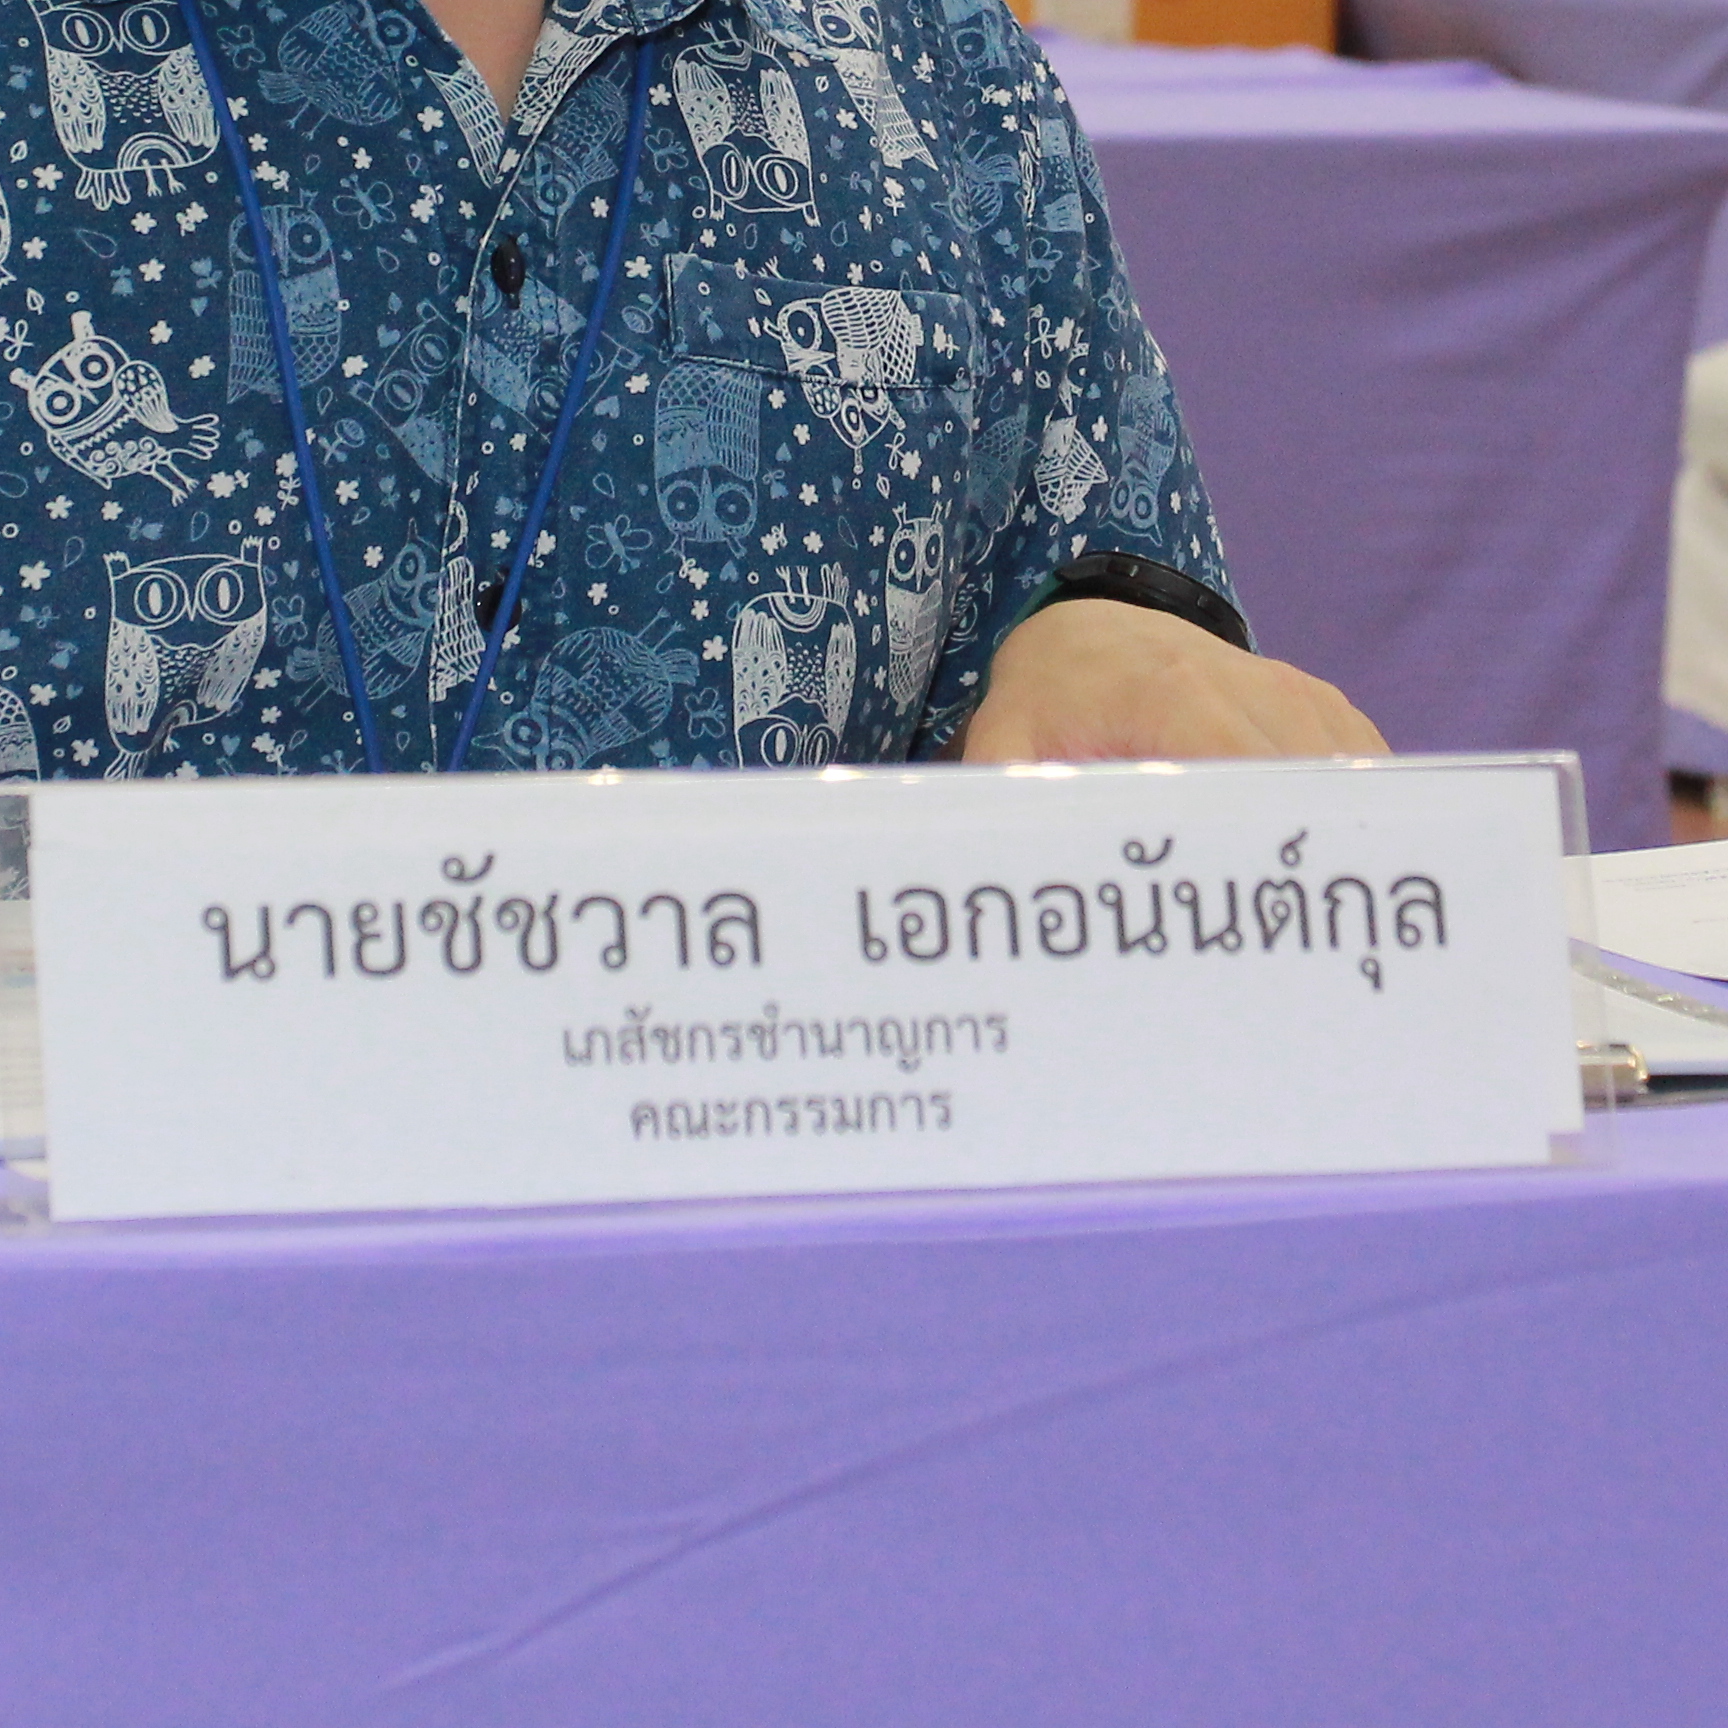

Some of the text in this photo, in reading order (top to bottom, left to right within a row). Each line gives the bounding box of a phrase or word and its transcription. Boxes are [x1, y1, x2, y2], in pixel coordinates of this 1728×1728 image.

[203, 830, 1448, 993] นายชัชวาล เอกอนันต์กุล
[562, 1002, 1009, 1072] เภสัชกรชำนาญการ
[628, 1092, 953, 1139] คณะกรรมการ
